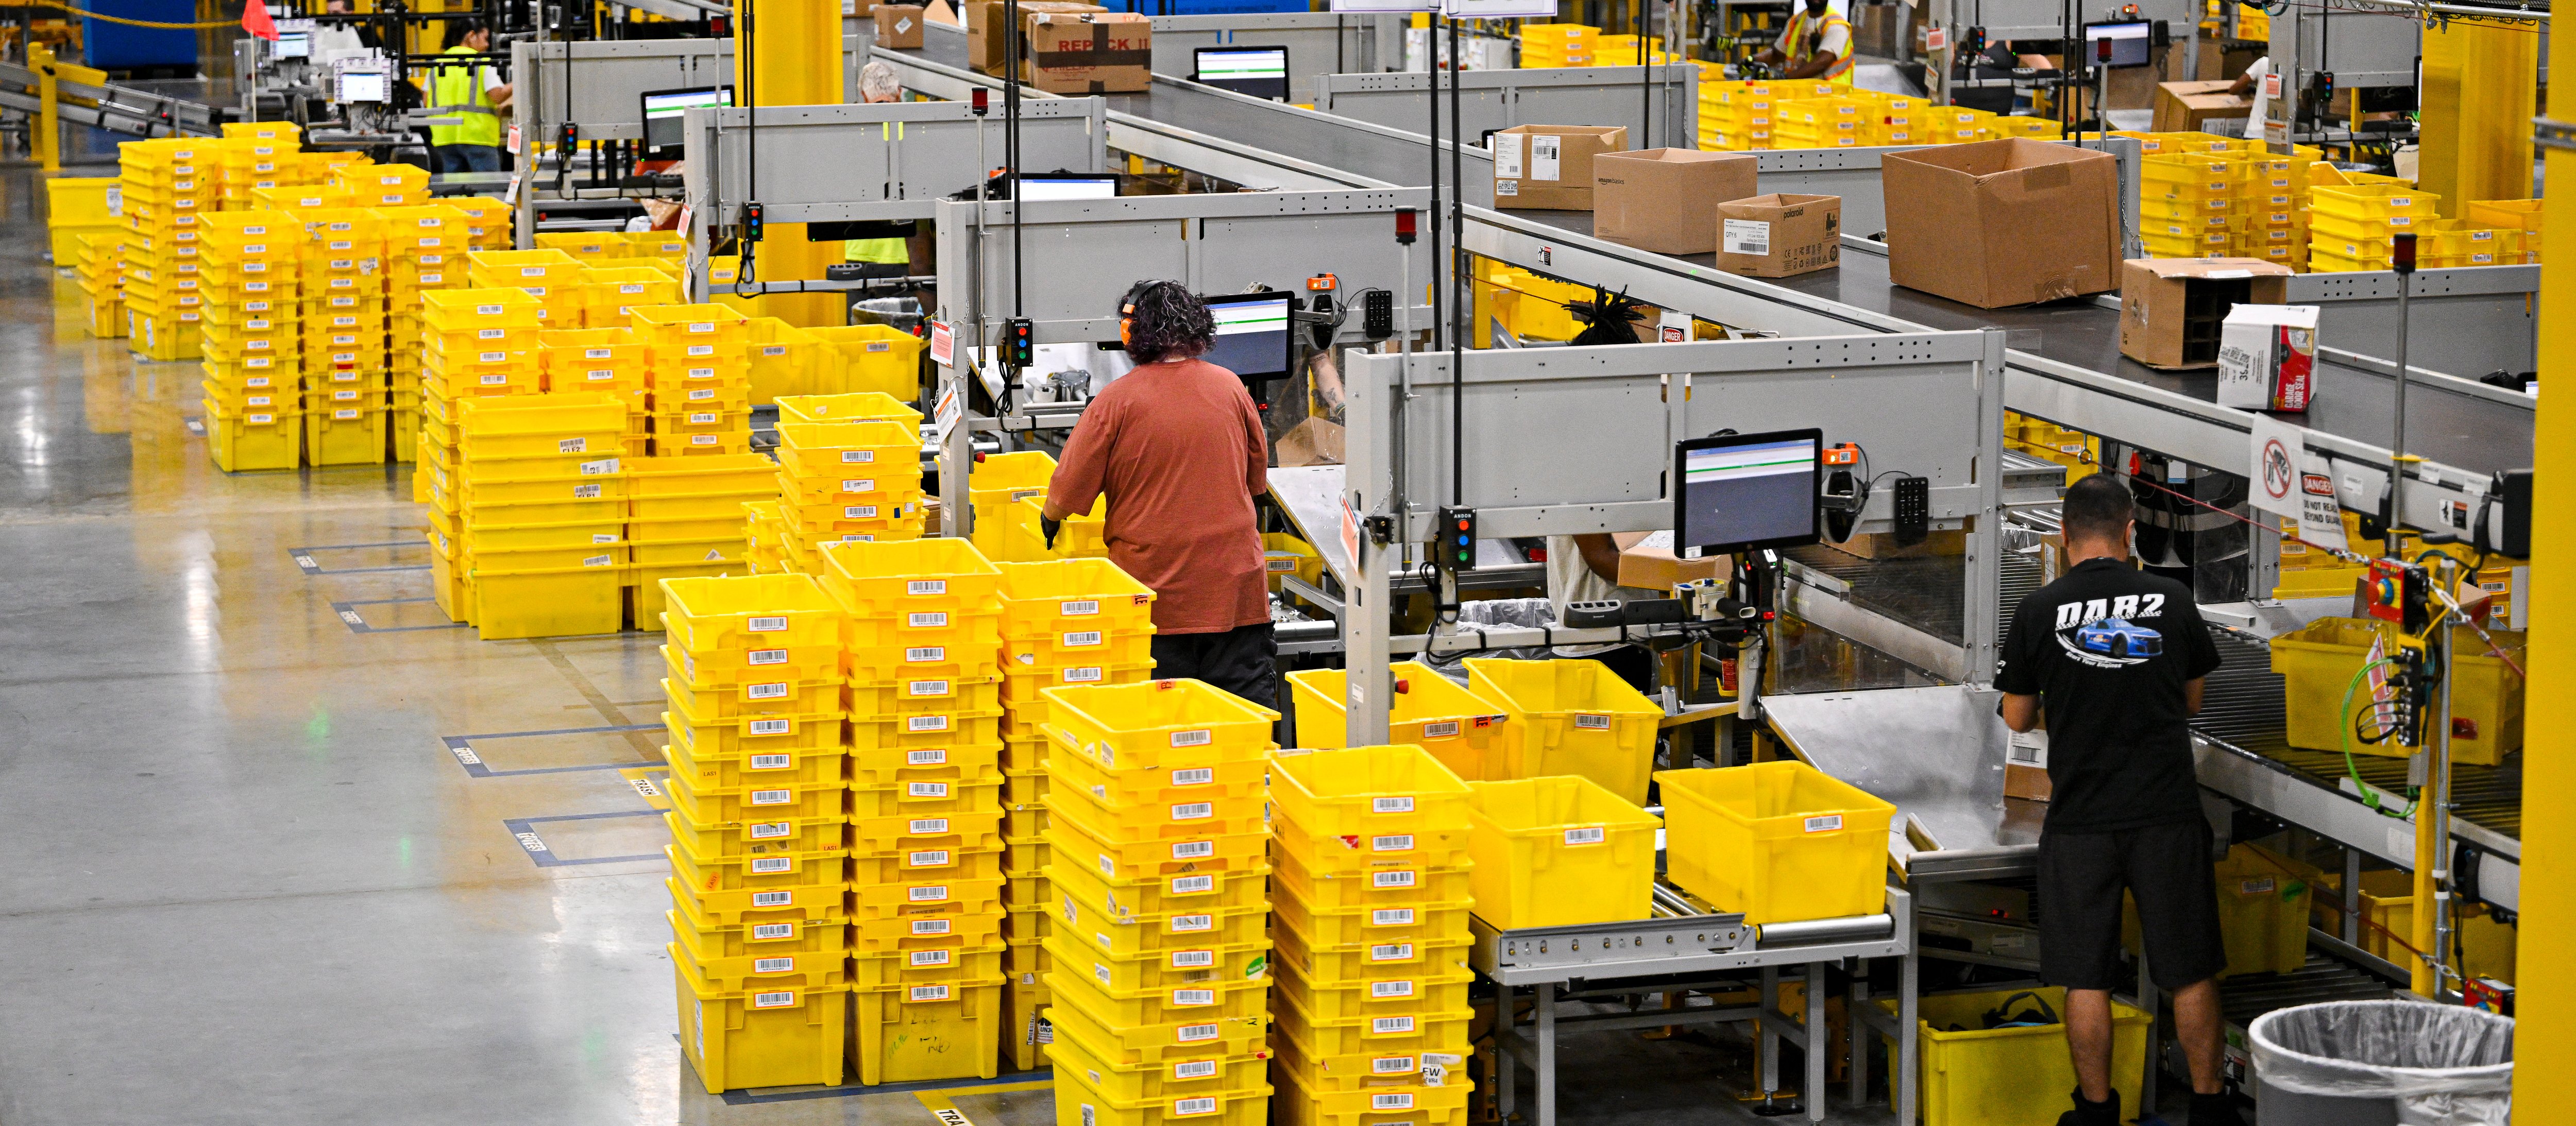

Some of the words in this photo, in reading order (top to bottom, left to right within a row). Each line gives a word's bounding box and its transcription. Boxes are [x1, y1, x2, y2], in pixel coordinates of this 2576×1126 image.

[1058, 38, 1130, 52] REPCK
[1783, 207, 1803, 221] polaroid
[1664, 331, 1681, 341] DANGER
[2296, 374, 2306, 390] SEAL
[2284, 383, 2295, 408] GARAGE
[2294, 390, 2304, 408] DOOR
[2055, 593, 2165, 631] DAB2
[2065, 651, 2081, 662] Start
[2081, 657, 2097, 666] Your
[456, 748, 477, 763] TOTES
[632, 779, 656, 796] TRASH
[519, 833, 542, 851] TOTES
[708, 876, 717, 889] LAS1
[939, 1110, 967, 1126] TRA
